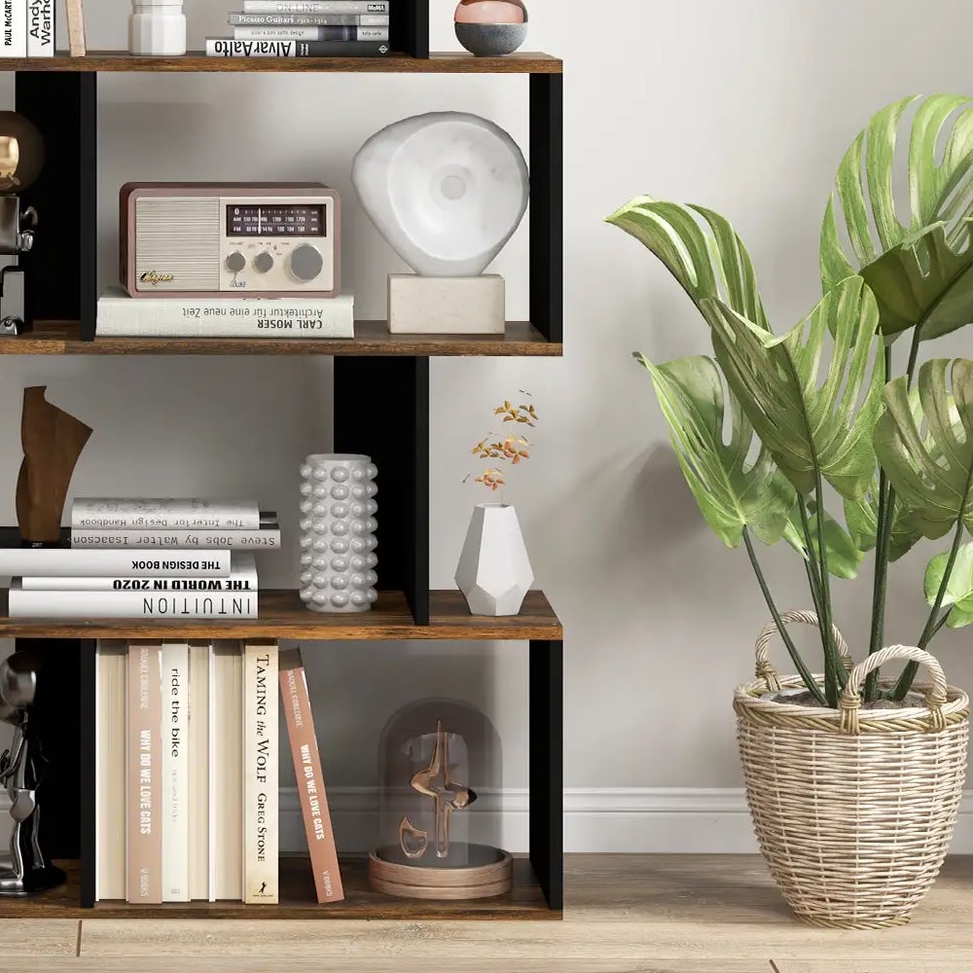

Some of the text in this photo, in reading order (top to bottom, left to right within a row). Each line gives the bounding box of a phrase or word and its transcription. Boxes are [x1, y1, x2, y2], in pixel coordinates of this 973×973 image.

[238, 15, 265, 23] Picasso
[4, 28, 12, 46] PAUL
[182, 308, 324, 318] Architektur für eine neue Zeit
[257, 319, 323, 329] CARL MOSER
[79, 517, 244, 527] The Interior Design Handbook
[136, 536, 178, 546] Walter
[185, 534, 199, 546] by
[206, 536, 233, 546] Jobs
[240, 537, 275, 546] Steve
[132, 560, 221, 570] THE DESIGN BOOK
[113, 579, 251, 590] THE WORLD IN 2020
[143, 598, 251, 614] INTUITION
[171, 668, 180, 757] ride the bike
[256, 654, 270, 784] TAMING the WOLF
[140, 730, 151, 835] WHY DO WE LOVE CATS
[300, 744, 325, 840] WHY DO WE LOVE CATS
[257, 793, 268, 862] GREG STONE
